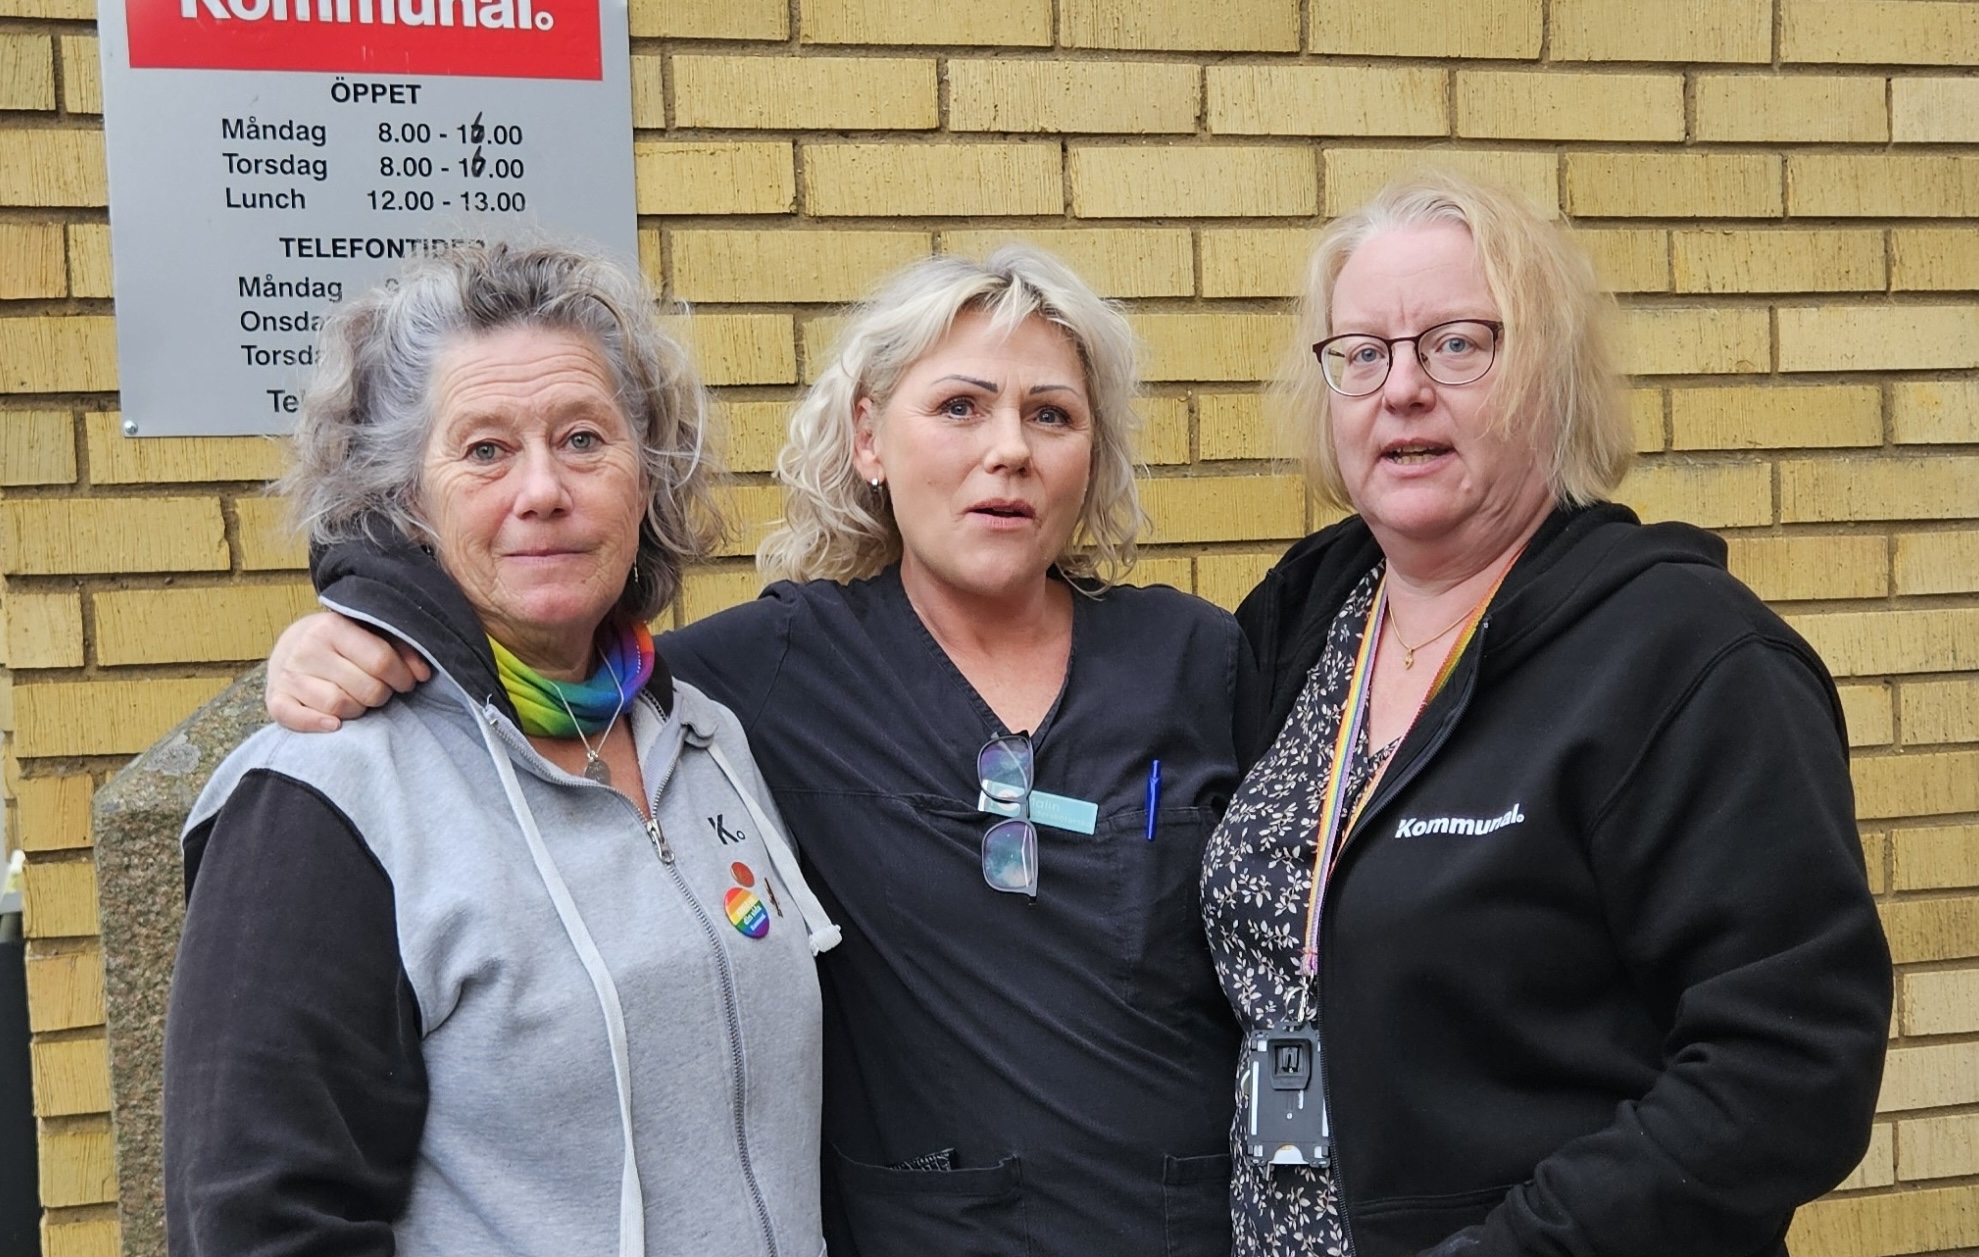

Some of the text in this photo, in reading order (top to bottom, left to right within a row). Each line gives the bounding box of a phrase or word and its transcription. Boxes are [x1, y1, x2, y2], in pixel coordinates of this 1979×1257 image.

[330, 76, 422, 105] ÖPPET
[221, 115, 327, 147] Måndag
[378, 122, 431, 143] 8.00
[222, 152, 328, 182] Torsdag
[380, 156, 433, 177] 8.00
[225, 187, 306, 209] Lunch
[367, 190, 434, 211] 12.00
[460, 191, 526, 212] 13.00
[238, 273, 343, 303] Måndag
[240, 310, 325, 332] Onsda
